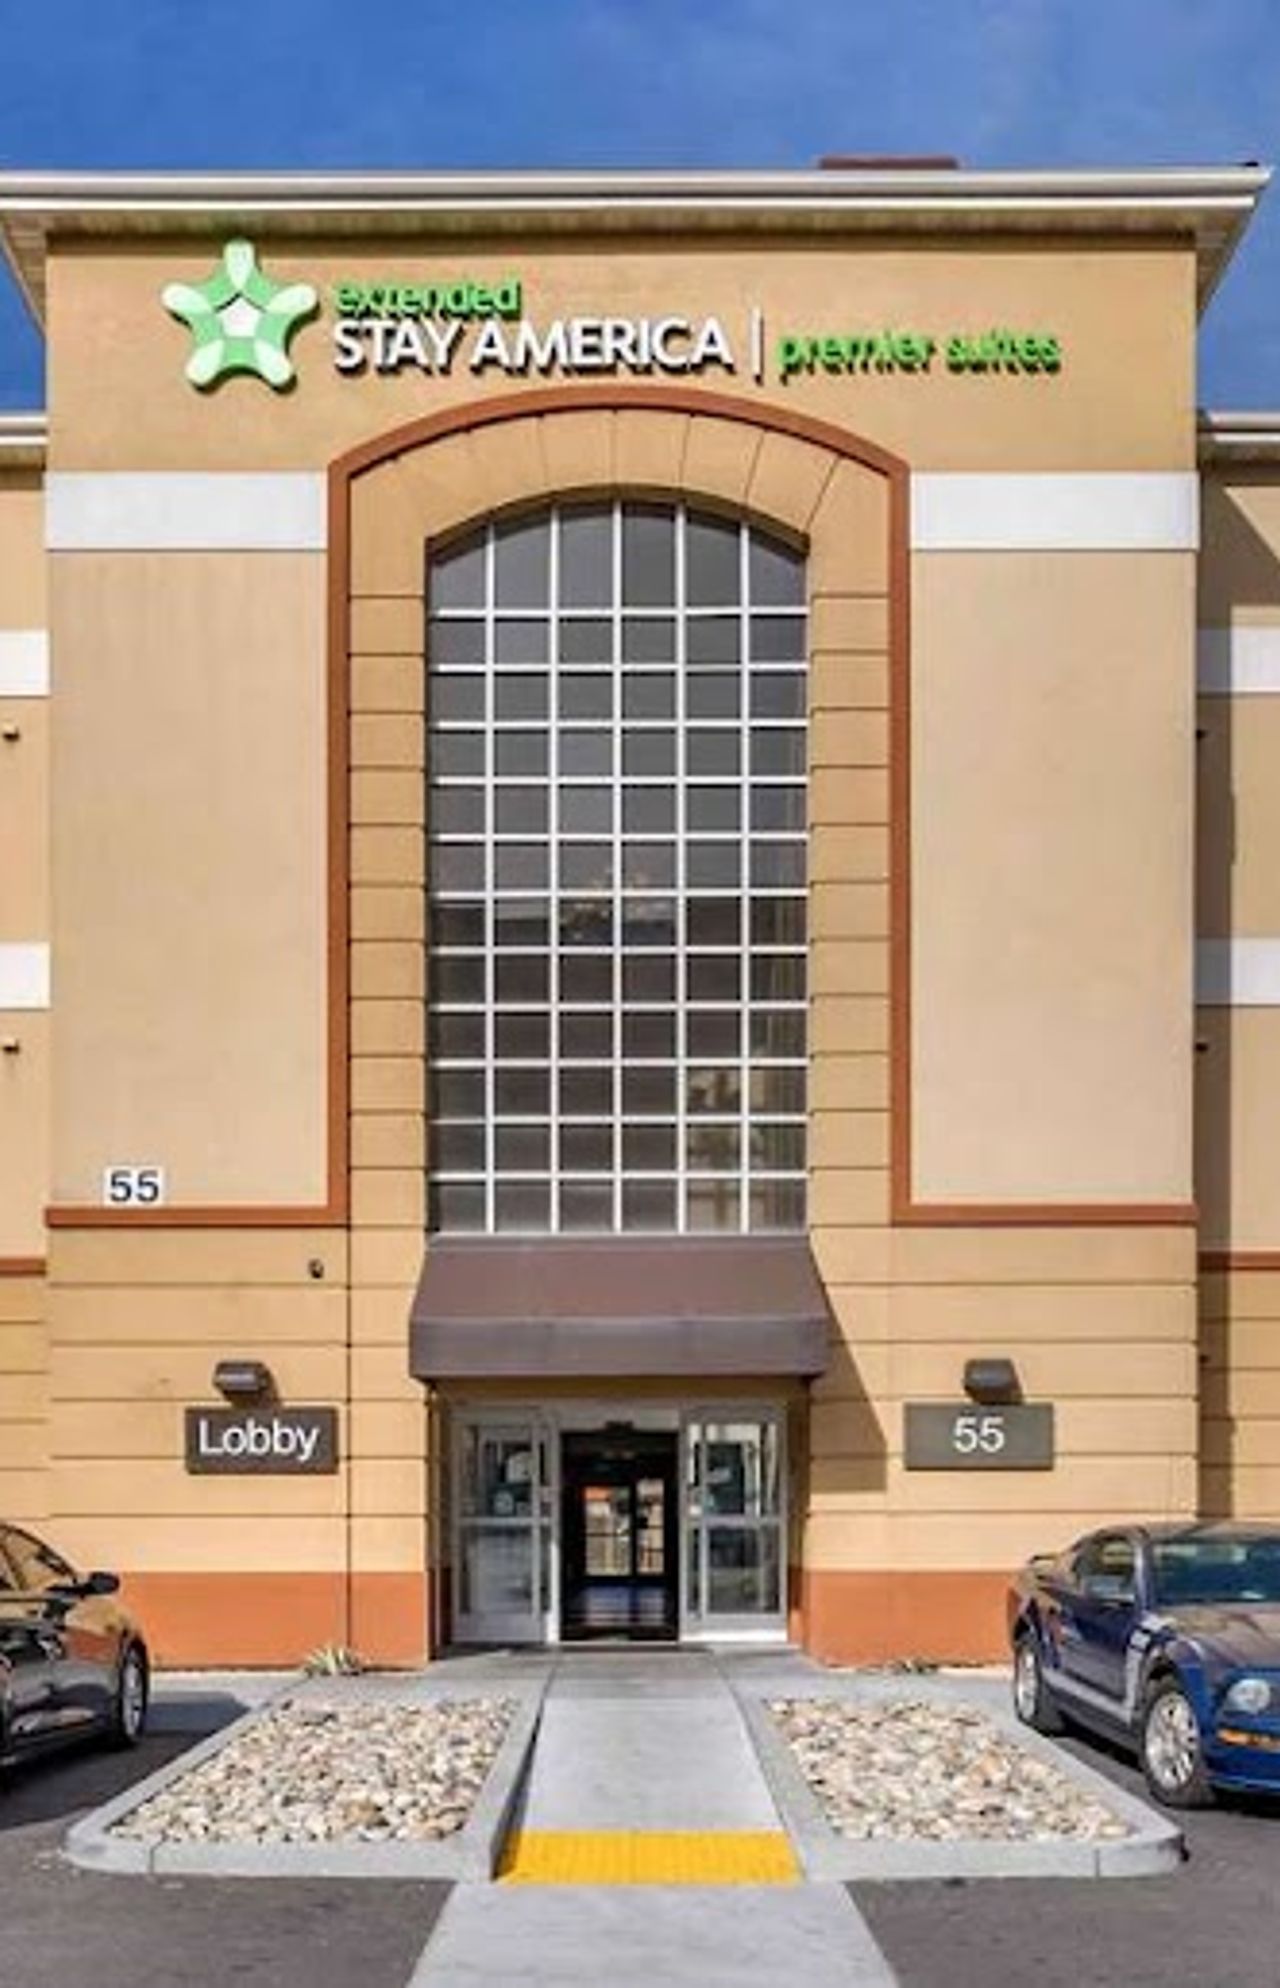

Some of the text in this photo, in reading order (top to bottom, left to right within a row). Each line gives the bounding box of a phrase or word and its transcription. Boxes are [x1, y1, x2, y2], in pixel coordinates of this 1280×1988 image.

[335, 280, 522, 316] extended
[333, 318, 734, 372] STAY AMERICA
[779, 329, 1060, 377] premier suites
[110, 1169, 159, 1203] 55
[199, 1418, 319, 1462] Lobby
[953, 1416, 1005, 1453] 55
